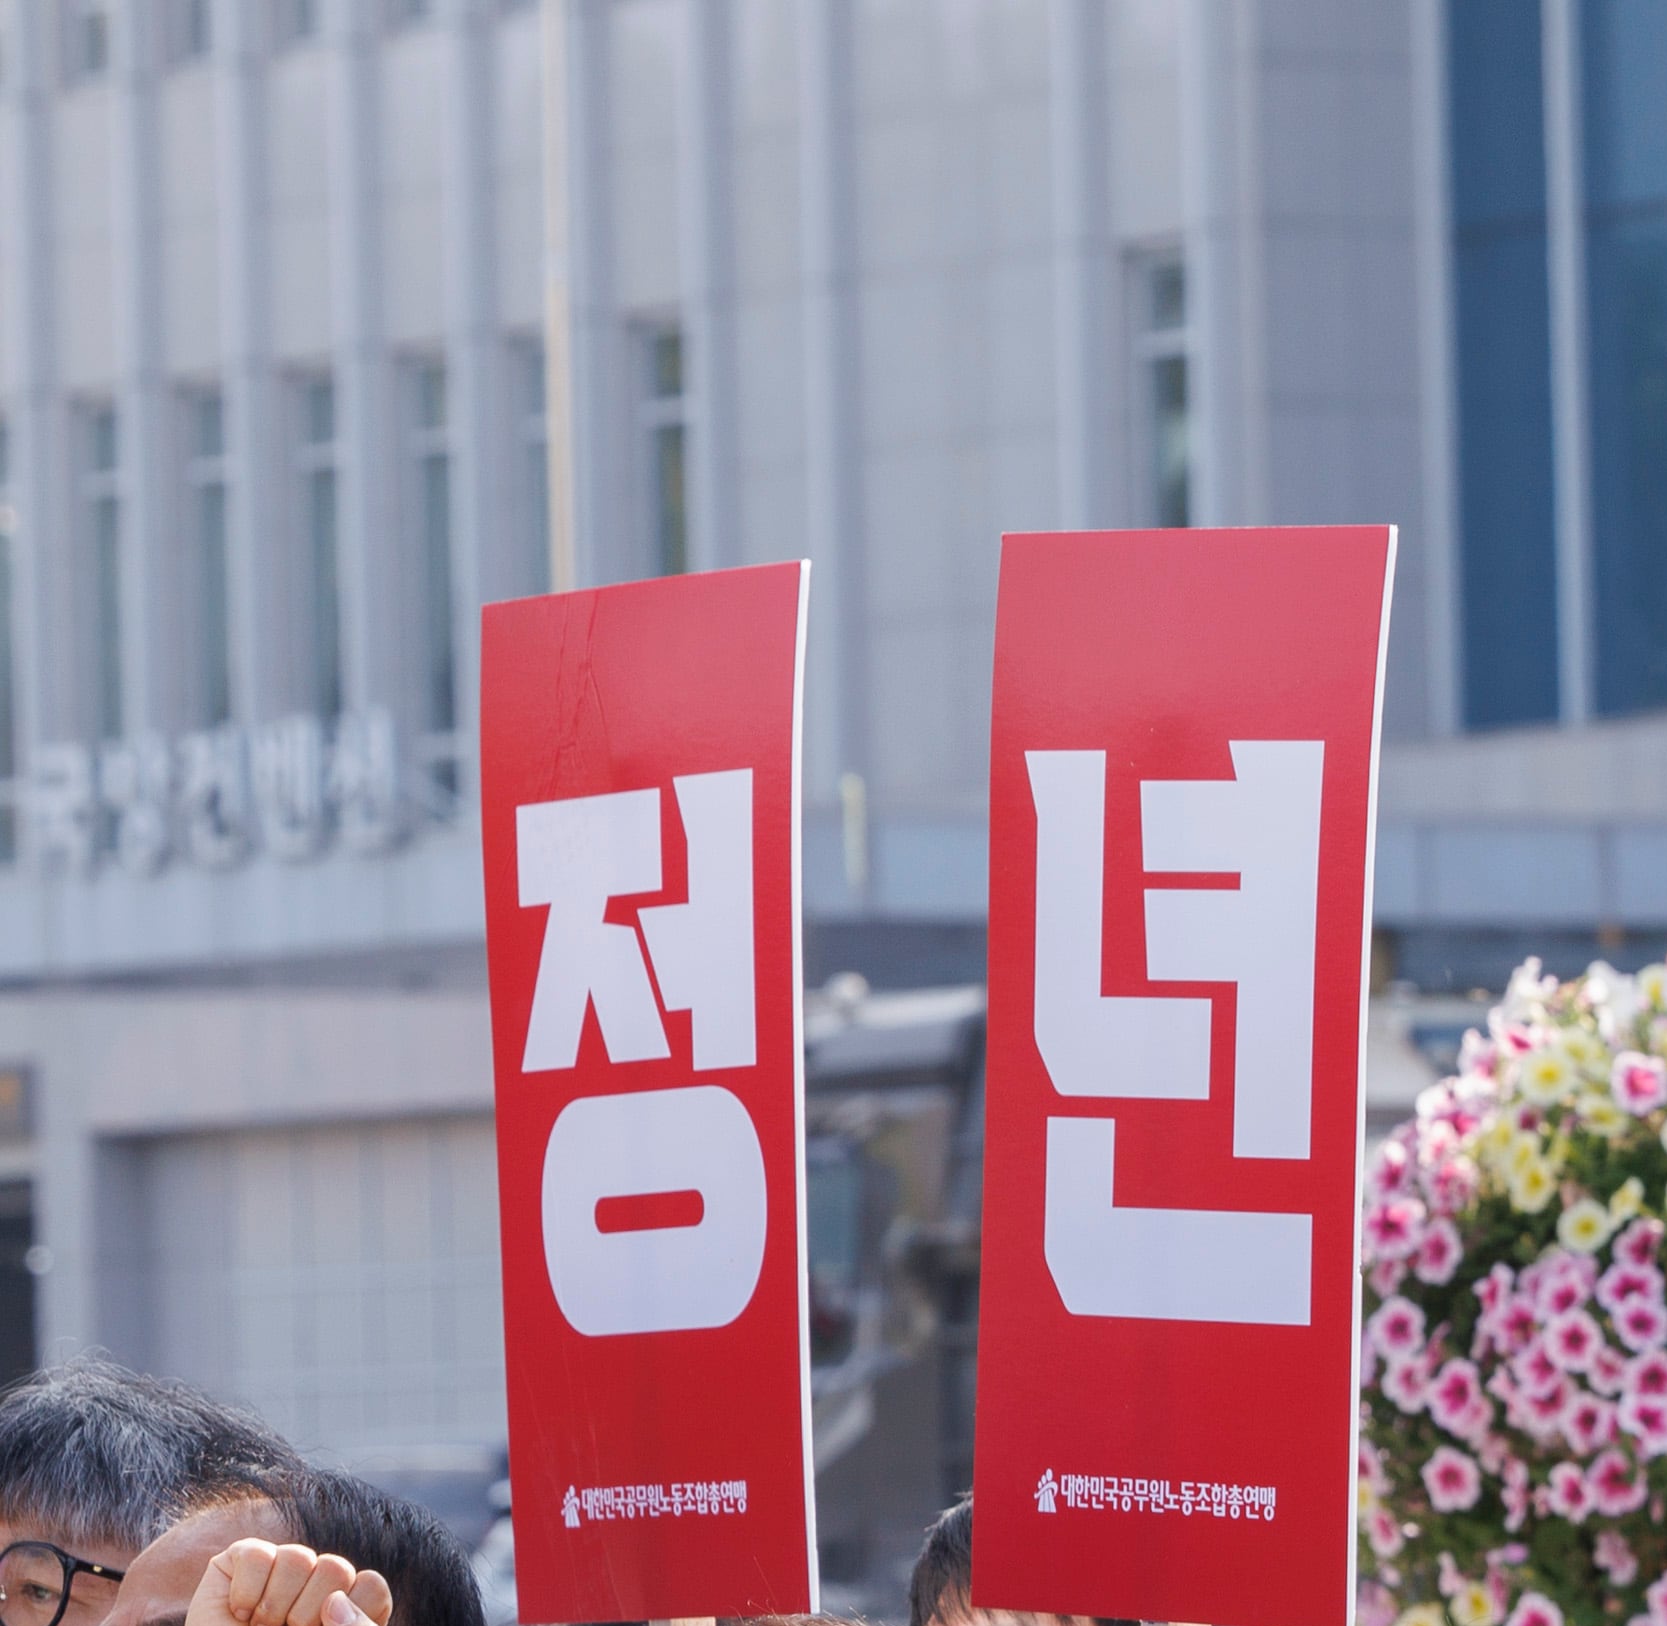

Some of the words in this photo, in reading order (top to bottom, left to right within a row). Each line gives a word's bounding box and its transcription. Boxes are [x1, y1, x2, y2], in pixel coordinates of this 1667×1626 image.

[516, 768, 767, 1337] 정
[1024, 740, 1325, 1325] 년
[581, 1480, 747, 1519] 대한민국공무원노동조합총연맹
[1061, 1475, 1276, 1520] 대한민국공무원노동조합총연맹
